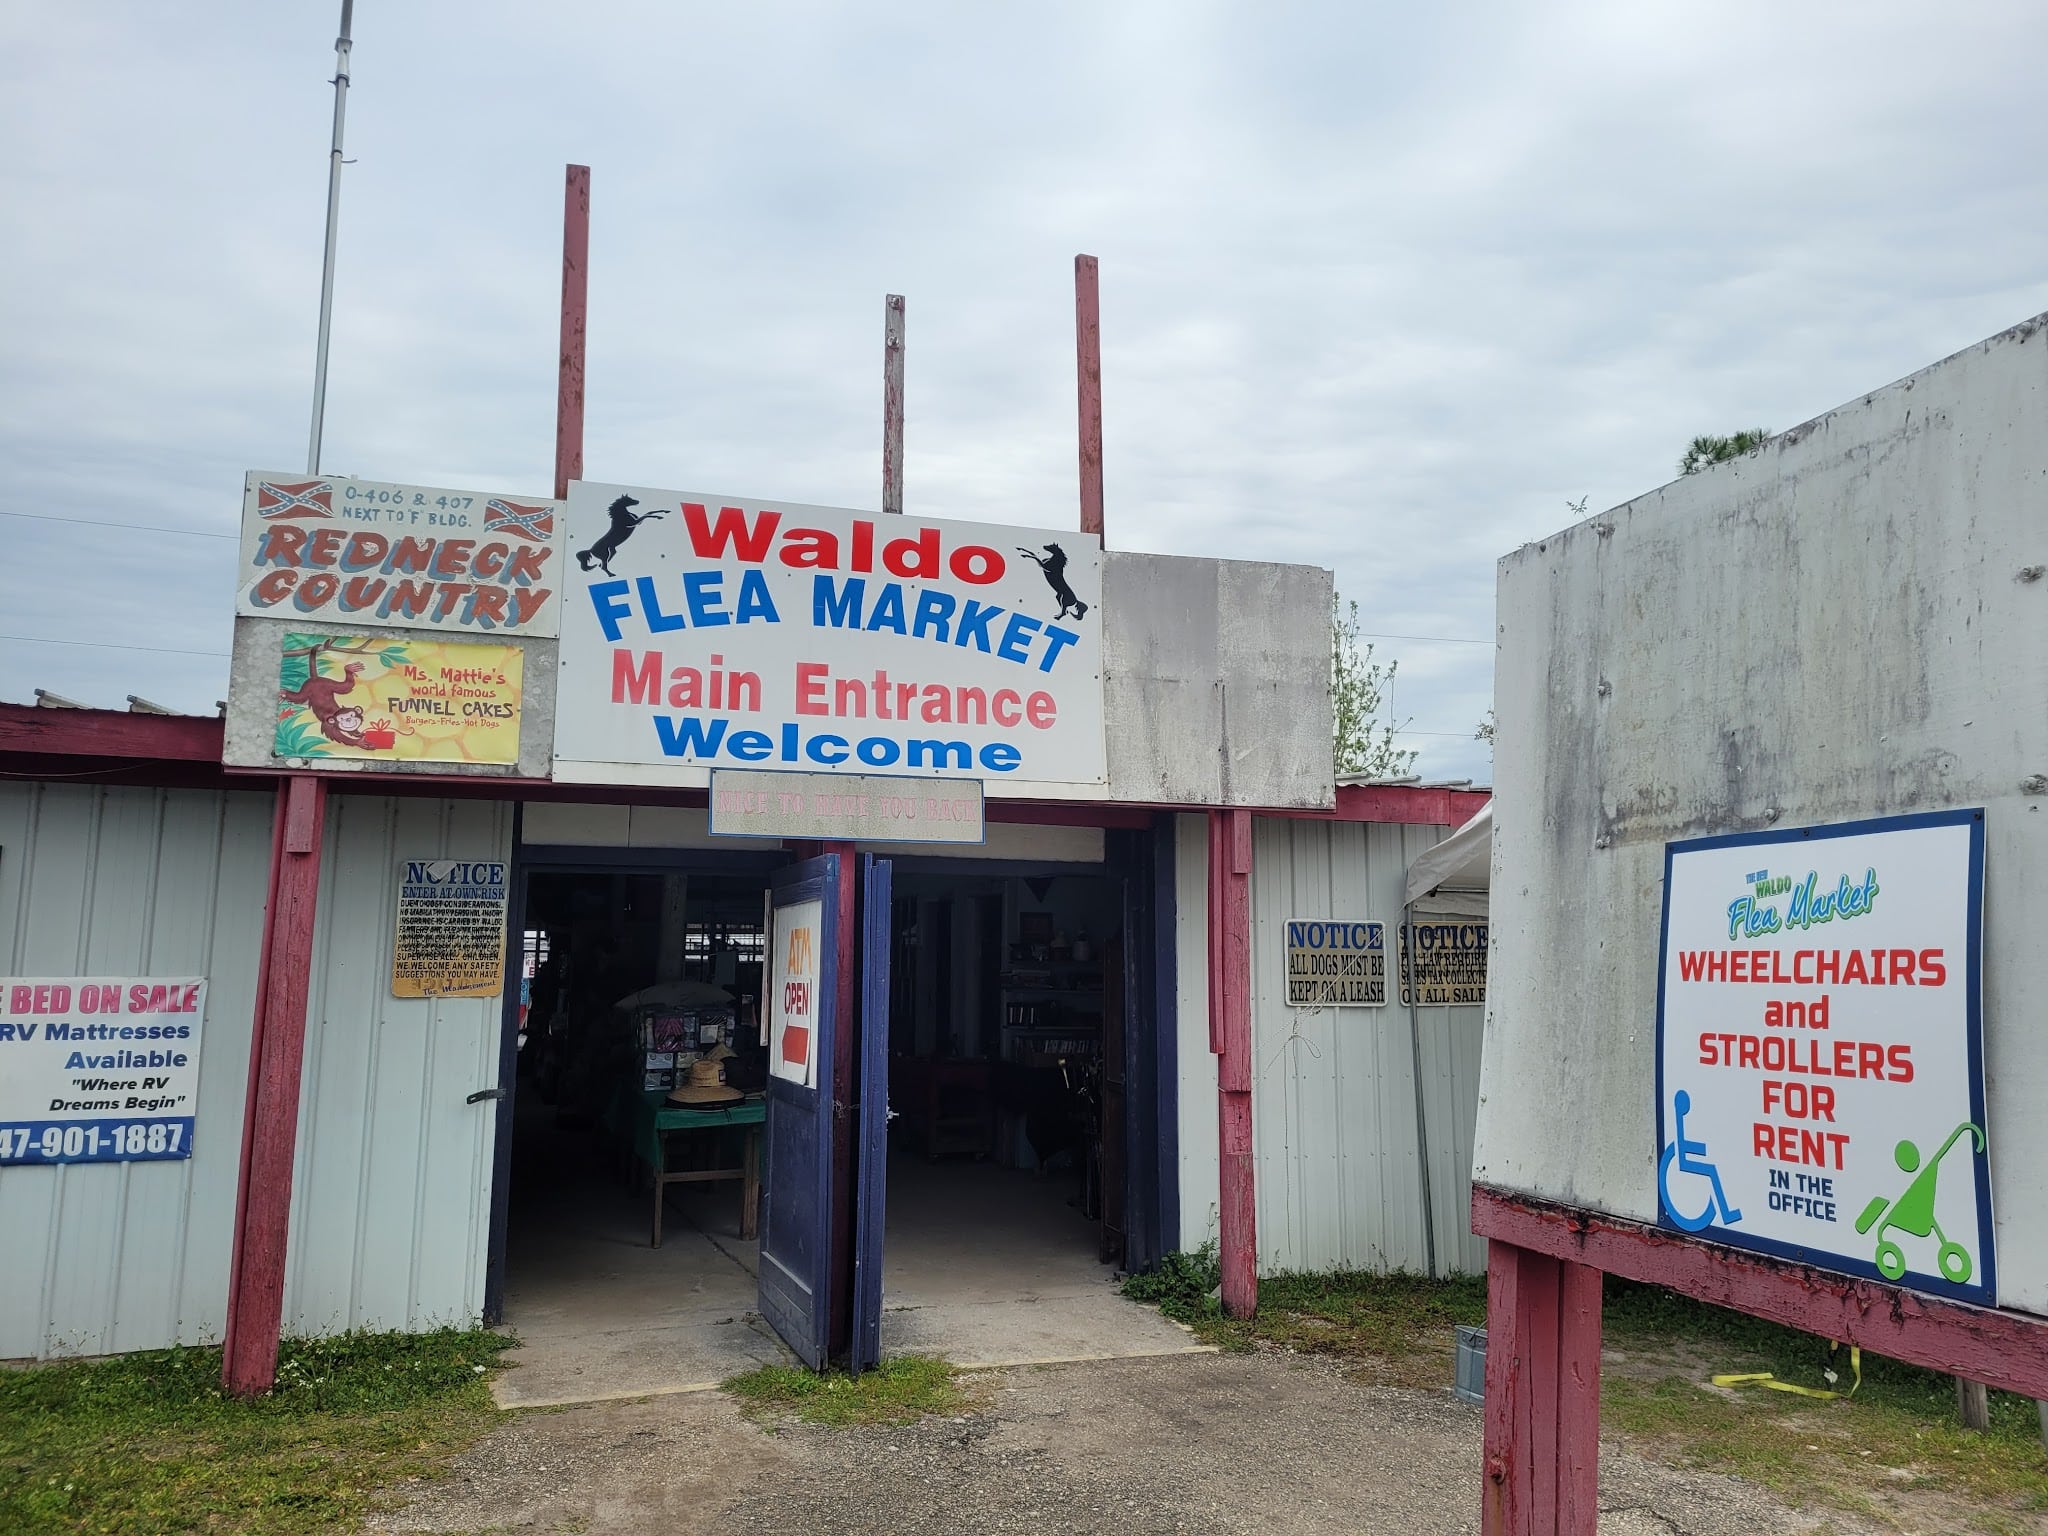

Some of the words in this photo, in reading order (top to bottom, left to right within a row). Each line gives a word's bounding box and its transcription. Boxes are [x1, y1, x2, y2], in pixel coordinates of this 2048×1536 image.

[412, 493, 427, 506] &
[435, 496, 474, 510] 407
[342, 506, 381, 522] NEXT
[386, 509, 404, 522] TO
[428, 512, 472, 528] BLDG.
[253, 524, 553, 587] REDNECK
[680, 502, 1007, 585] Waldo
[250, 568, 553, 630] COUNTRY
[588, 569, 780, 642] FLEA
[812, 574, 1081, 673] MARKET
[404, 665, 432, 682] Ms.
[440, 667, 506, 685] Mattie's
[411, 682, 446, 697] world
[451, 684, 497, 698] famous
[611, 648, 762, 713] Main
[795, 661, 1058, 730] Entrance
[388, 697, 456, 715] FUNNEL
[462, 701, 514, 719] CAKES
[653, 715, 1022, 772] Welcome
[718, 790, 769, 815] NICE
[778, 792, 804, 815] TO
[815, 794, 869, 817] HAVE
[879, 797, 916, 819] YOU
[926, 798, 977, 822] BACK
[402, 887, 435, 899] ENTER
[480, 888, 505, 900] RISK
[1755, 875, 1792, 899] WALDO
[1727, 895, 1782, 941] Flea
[1785, 866, 1880, 930] Market
[1288, 923, 1384, 950] NOTICE
[788, 927, 812, 976] ATM
[1289, 954, 1308, 975] ALL
[1311, 955, 1338, 976] DOGS
[1340, 955, 1369, 976] MUST
[1371, 955, 1384, 976] BE
[1444, 952, 1487, 966] REQUIRE
[395, 970, 445, 979] SUGGESTIONS
[448, 970, 461, 979] YOU
[464, 970, 477, 979] MAY
[396, 962, 410, 970] WE
[411, 962, 449, 970] WELCOME
[452, 962, 470, 970] ANY
[471, 962, 500, 970] SAFETY
[1446, 969, 1486, 985] COLLECTE
[1679, 949, 1947, 987] WHEELCHAIRS
[10, 985, 71, 1015] BED
[79, 985, 122, 1014] ON
[128, 984, 200, 1013] SALE
[784, 982, 809, 1016] OPEN
[1290, 980, 1319, 1001] KEPT
[1321, 980, 1337, 1001] ON
[1340, 980, 1347, 1001] A
[1350, 981, 1384, 1002] LEASH
[1425, 988, 1449, 1003] ALL
[1764, 994, 1830, 1030] and
[0, 1024, 38, 1042] RV
[45, 1022, 190, 1041] Mattresses
[64, 1050, 188, 1070] Available
[1699, 1033, 1915, 1083] STROLLERS
[72, 1078, 137, 1091] "Where
[142, 1077, 169, 1090] RV
[49, 1098, 120, 1112] Dreams
[124, 1095, 186, 1111] Begin"
[1762, 1080, 1836, 1122] FOR
[1753, 1123, 1849, 1170] RENT
[1769, 1169, 1790, 1188] IN
[1795, 1172, 1834, 1198] THE
[1768, 1190, 1837, 1222] OFFICE
